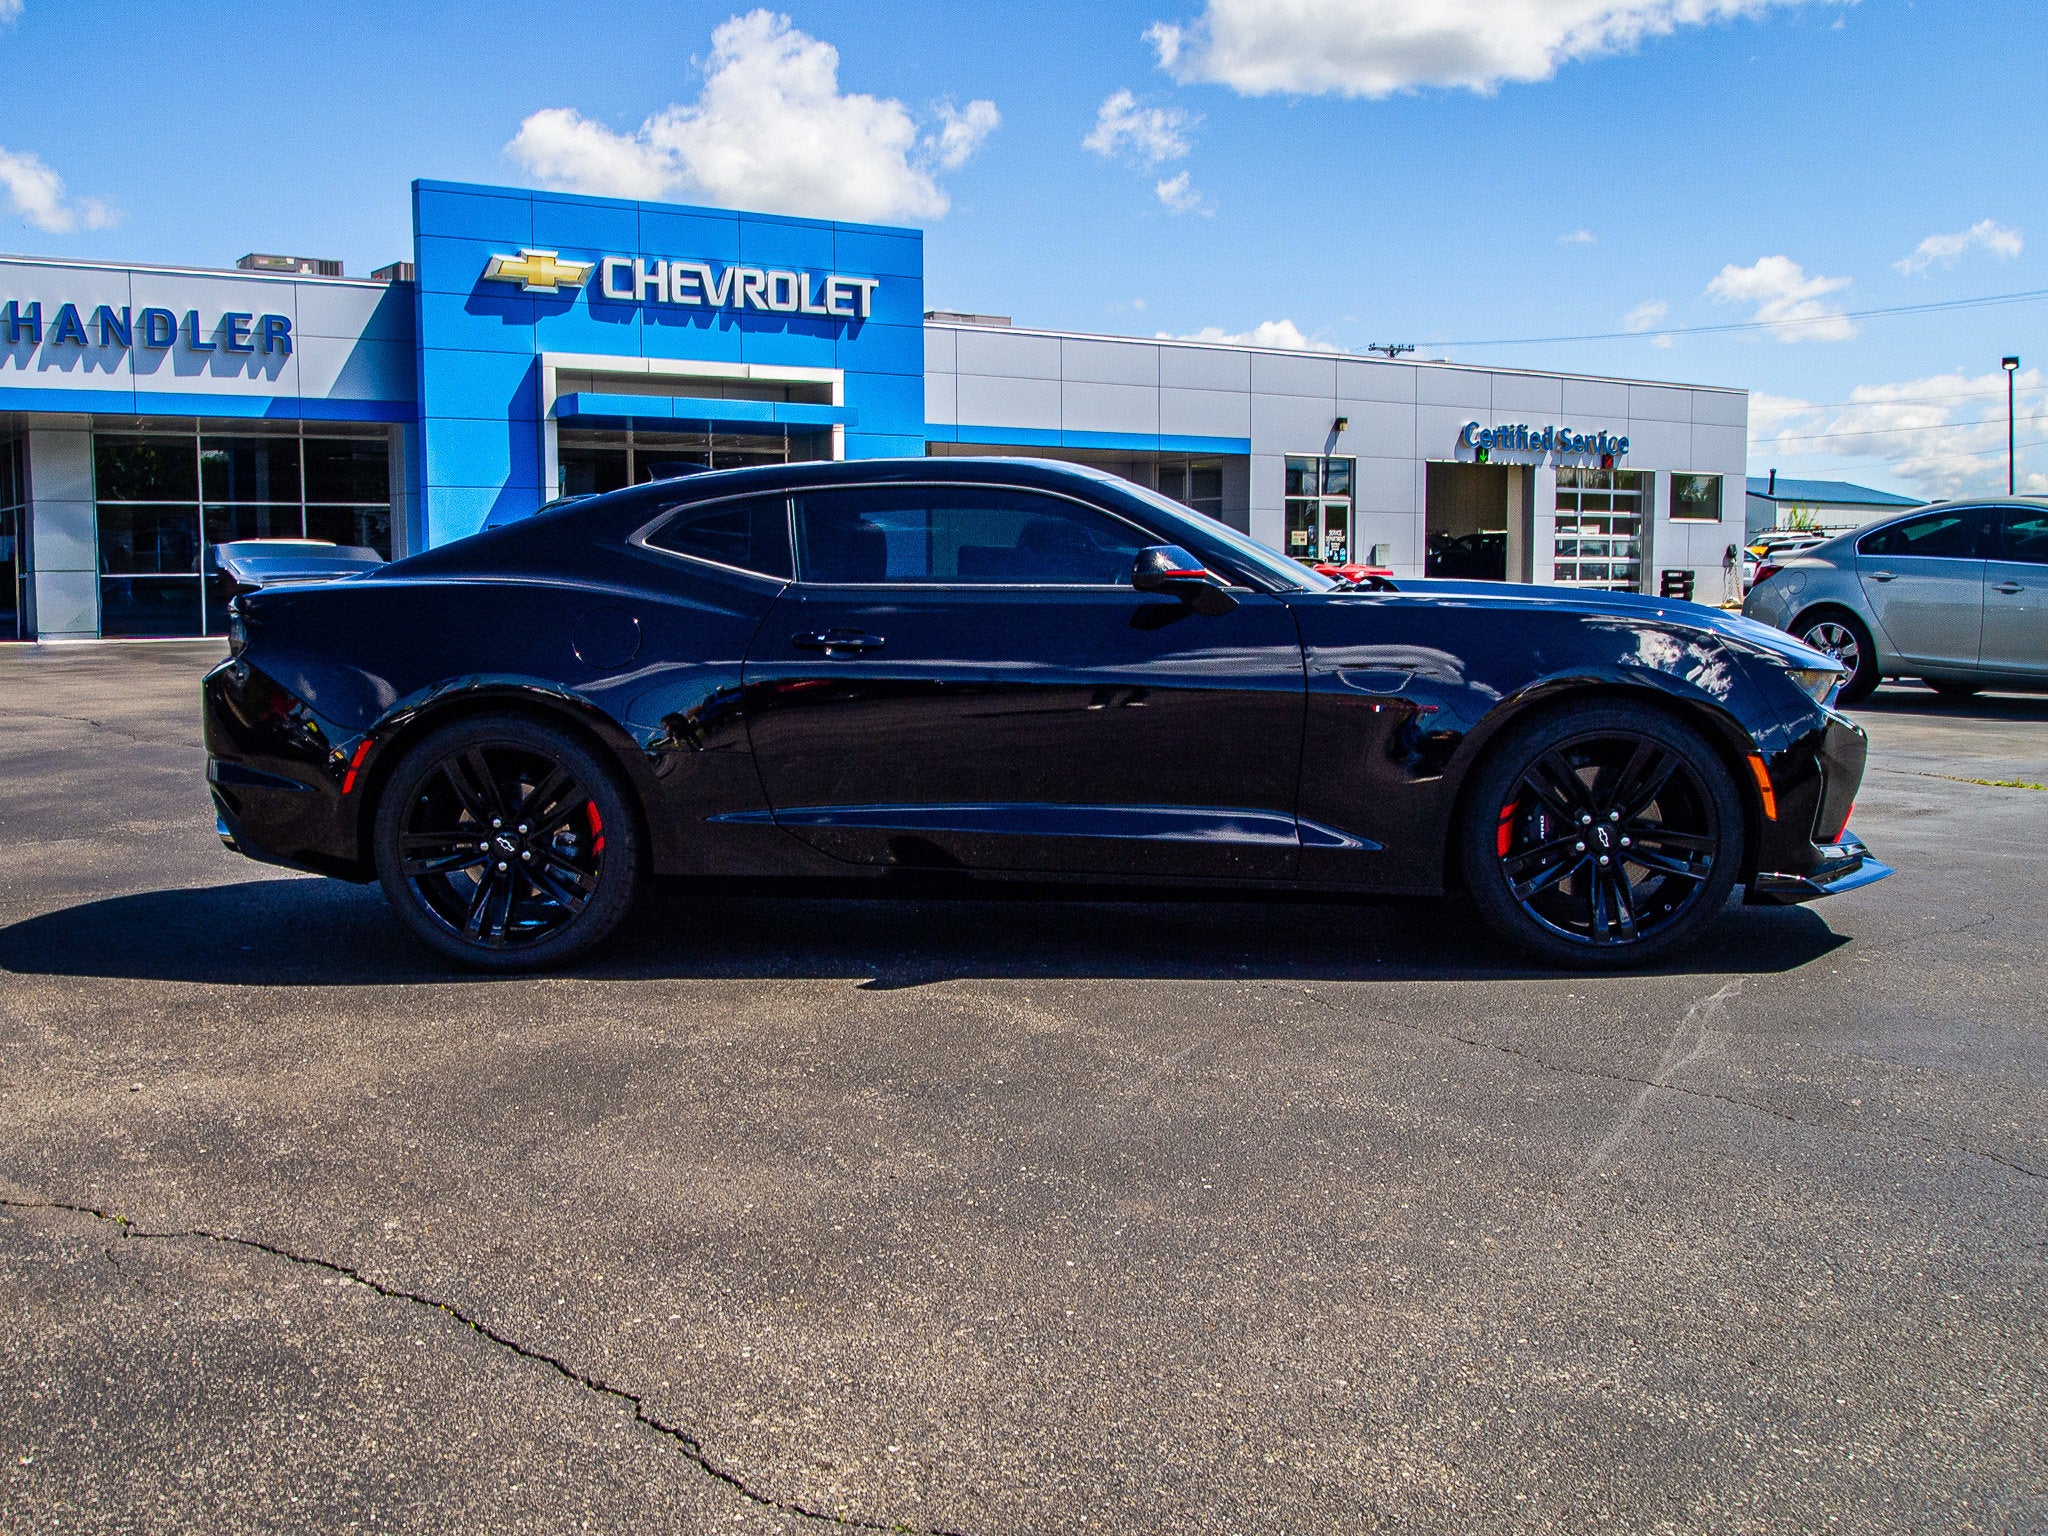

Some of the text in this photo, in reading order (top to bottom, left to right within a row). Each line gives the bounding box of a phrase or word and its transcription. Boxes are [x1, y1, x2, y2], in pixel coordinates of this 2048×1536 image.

[602, 257, 880, 318] CHEVROLET
[8, 300, 293, 354] HANDLER
[1464, 421, 1630, 455] Certified Service
